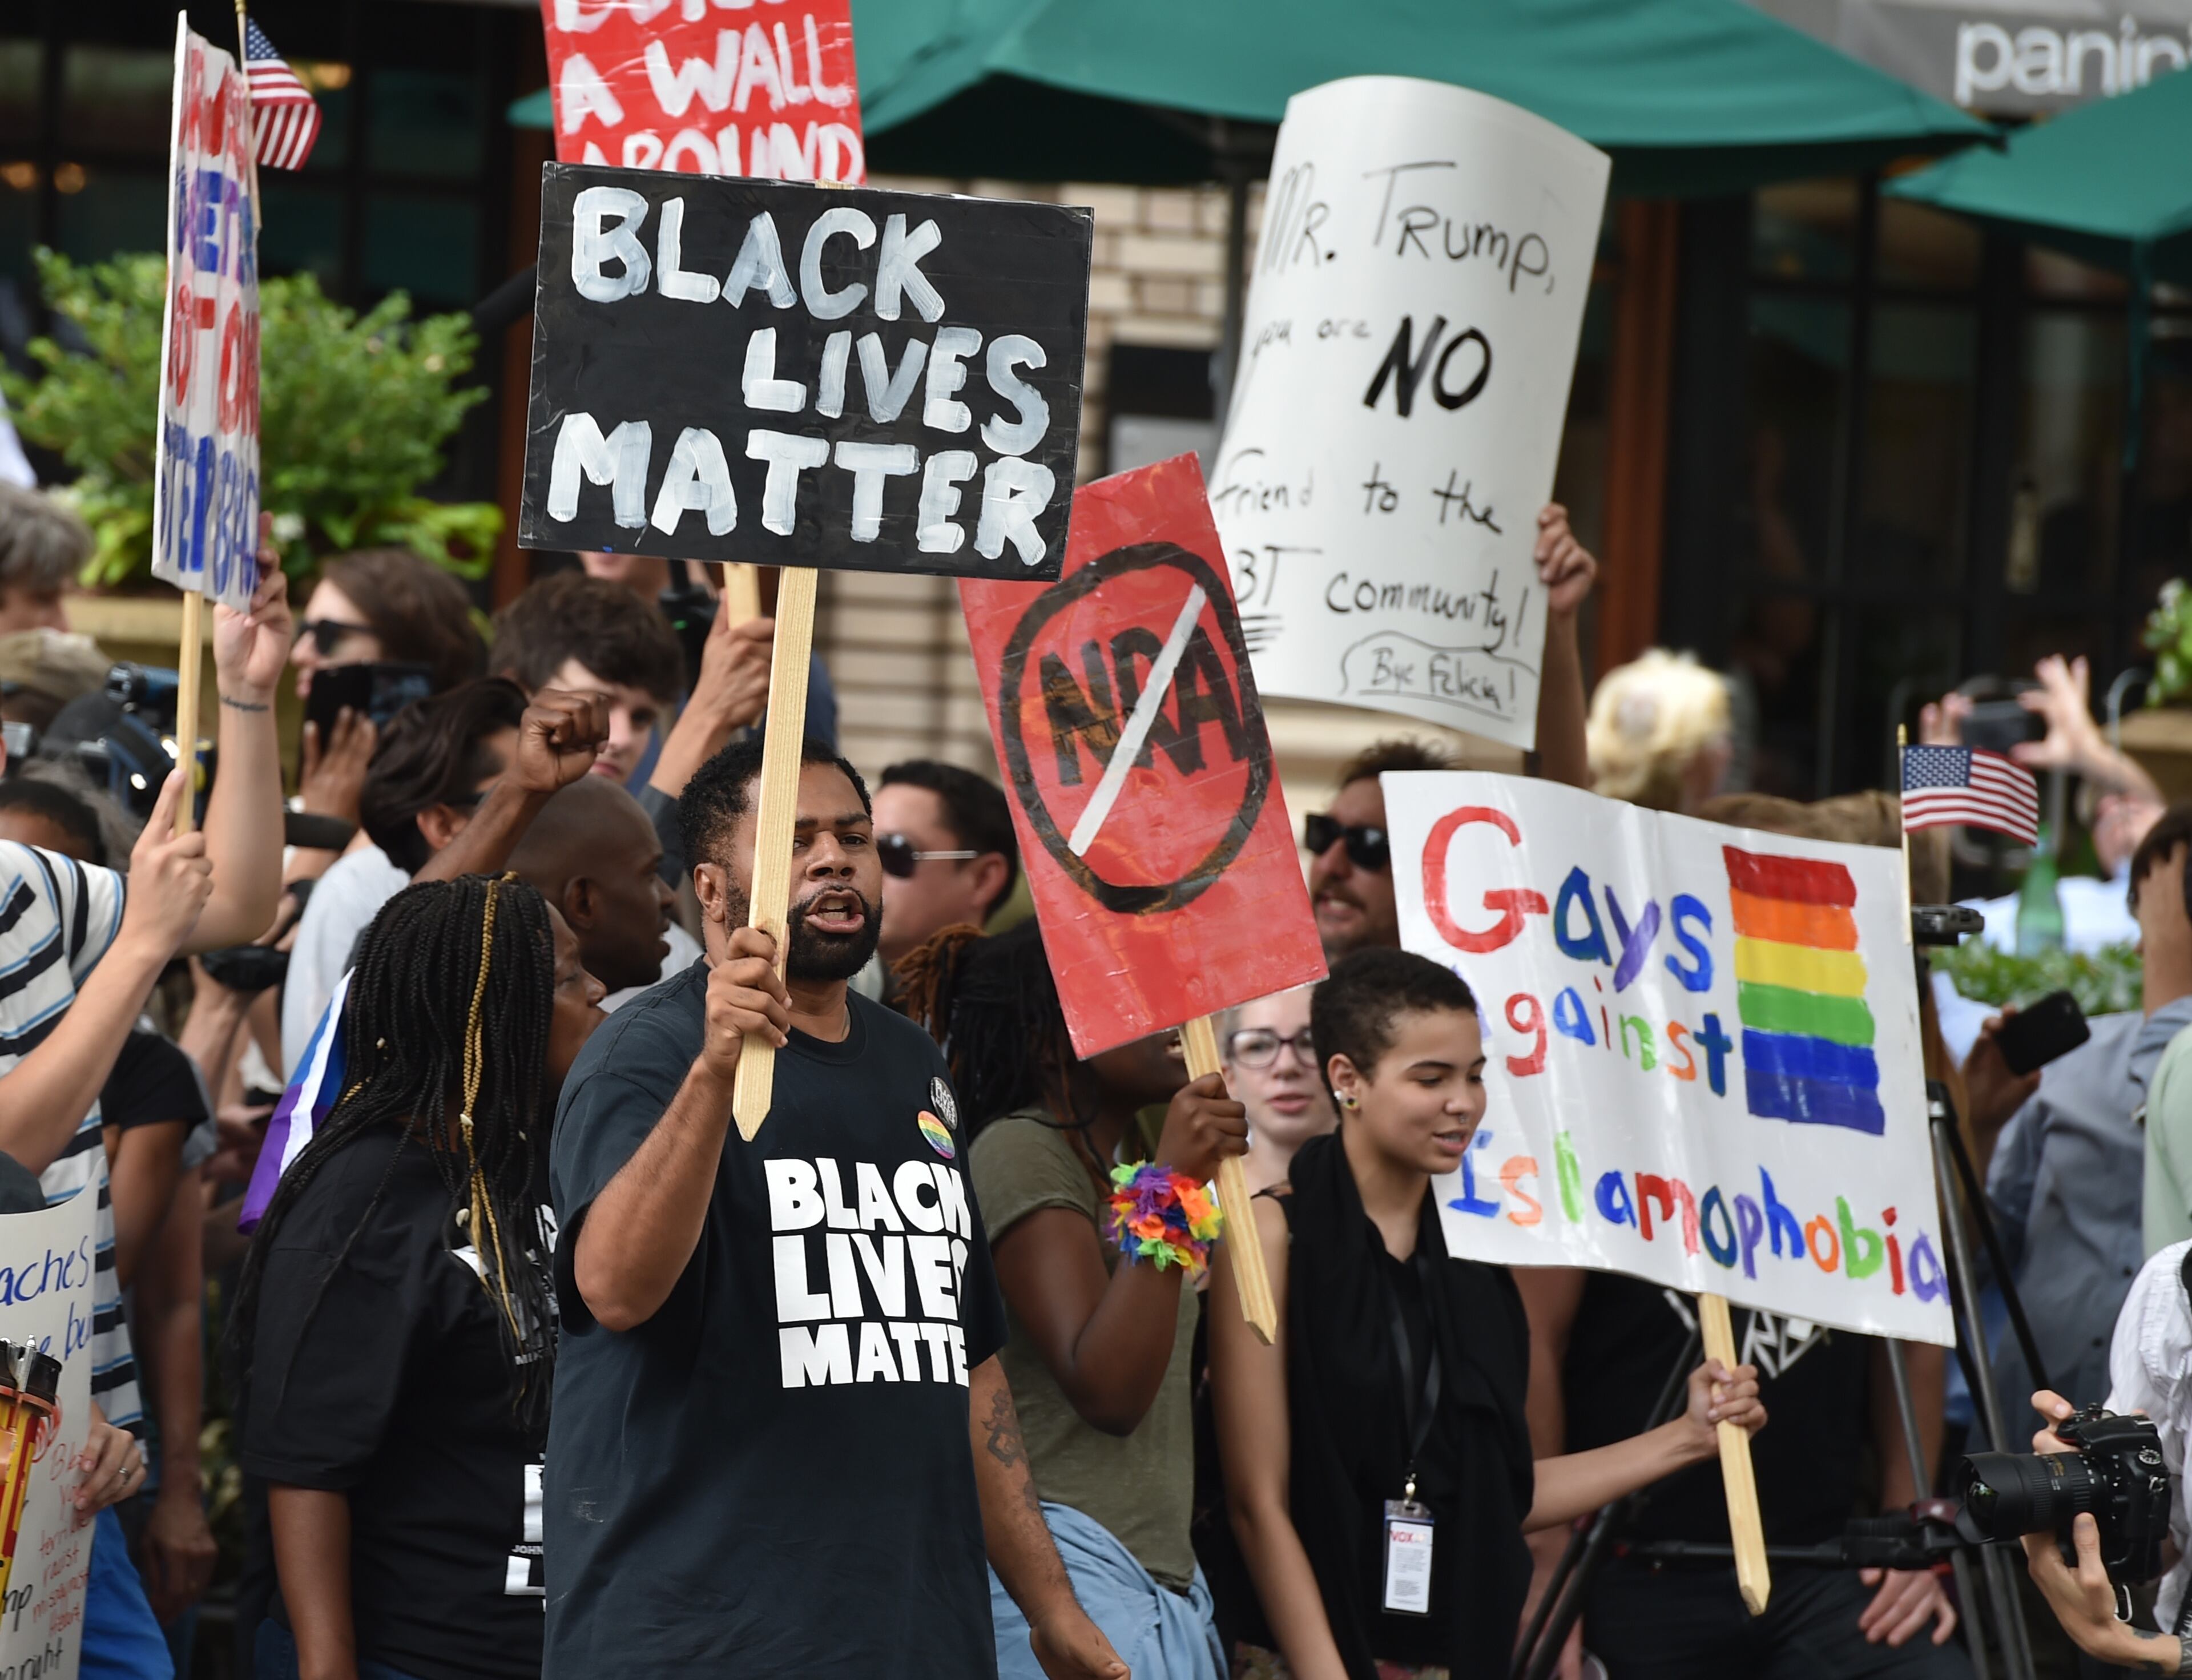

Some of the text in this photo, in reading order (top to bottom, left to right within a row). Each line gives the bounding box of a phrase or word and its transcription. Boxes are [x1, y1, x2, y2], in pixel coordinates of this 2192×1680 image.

[562, 14, 852, 134] A WALL
[1954, 13, 2192, 106] panin
[571, 186, 945, 323] BLACK
[742, 326, 1050, 456] LIVES
[1363, 314, 1492, 421] NO
[546, 412, 1055, 566] MATTER
[1362, 462, 1400, 514] to
[1432, 469, 1502, 535] the
[1236, 546, 1323, 607] BT
[1039, 626, 1249, 787] NRA
[1371, 647, 1414, 693] Bye
[1421, 805, 1714, 993] Gays
[1453, 962, 1733, 1097] gainst
[763, 1157, 972, 1240] BLACK
[1447, 1129, 1952, 1307] Islamophobia
[778, 1322, 969, 1388] MATTE
